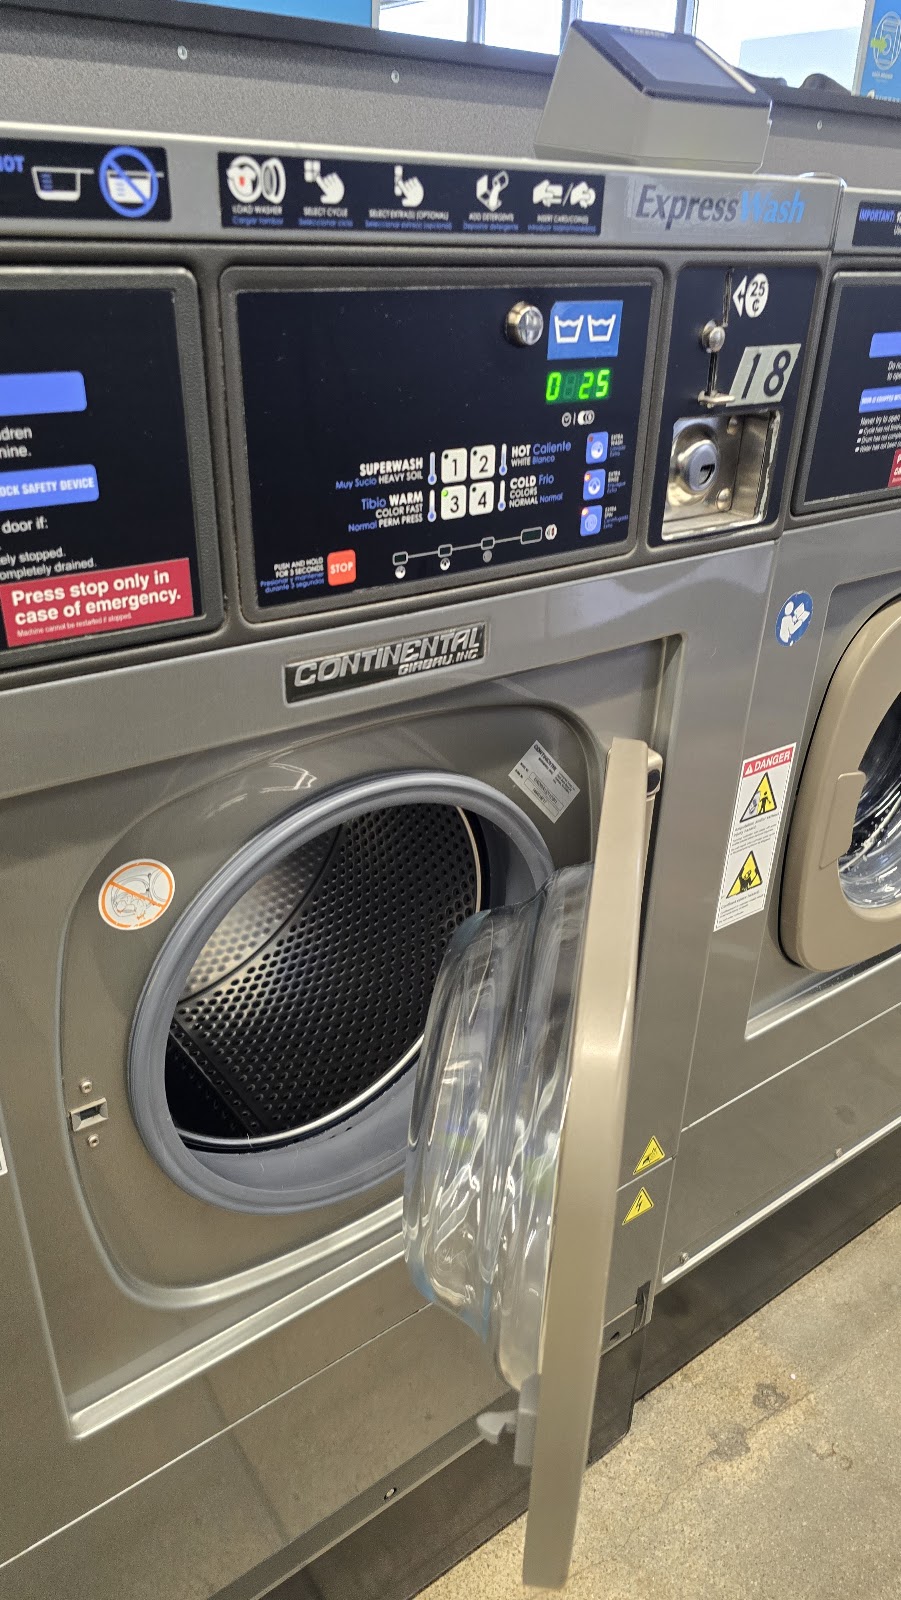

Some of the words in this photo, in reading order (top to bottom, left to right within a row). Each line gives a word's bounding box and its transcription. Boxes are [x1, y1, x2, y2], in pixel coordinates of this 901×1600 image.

[635, 184, 806, 231] ExpressWash
[750, 281, 766, 297] 25
[545, 371, 562, 401] 0
[578, 369, 611, 400] 25
[741, 351, 791, 399] 18
[0, 425, 33, 441] dren
[511, 444, 531, 458] HOT
[533, 440, 571, 455] Caliente
[359, 457, 423, 477] SUPERWASH
[452, 459, 458, 476] 1
[479, 455, 488, 473] 2
[511, 456, 531, 468] WHITE
[532, 455, 555, 465] Blanco
[0, 484, 20, 497] OCK
[22, 481, 57, 495] SAFETY
[60, 477, 95, 492] DEVICE
[335, 481, 353, 490] Muy
[355, 477, 377, 488] Sucio
[378, 472, 405, 484] HEAVY
[406, 470, 423, 481] SOIL
[510, 475, 536, 490] COLD
[361, 496, 387, 510] Tibio
[389, 490, 423, 506] WARM
[450, 495, 459, 513] 3
[478, 491, 487, 508] 4
[509, 496, 538, 508] NORMAL
[540, 492, 563, 503] Normal
[510, 486, 537, 499] COLORS
[375, 506, 405, 519] COLOR
[406, 503, 423, 514] FAST
[1, 519, 33, 534] door
[35, 515, 48, 530] if:
[348, 520, 377, 532] Normal
[378, 516, 400, 528] PERM
[401, 513, 423, 525] PRESS
[0, 553, 16, 567] ely
[18, 546, 66, 563] stopped.
[273, 562, 290, 571] PUSH
[291, 560, 305, 569] AND
[306, 556, 324, 566] HOLD
[0, 563, 52, 581] ompletely
[54, 557, 97, 573] drained.
[275, 570, 289, 578] FOR
[295, 565, 324, 575] SECONDS
[330, 561, 353, 574] STOP
[11, 587, 65, 607] Press
[69, 581, 109, 597] stop
[113, 573, 149, 592] only
[154, 570, 169, 585] in
[15, 608, 59, 626] case
[63, 601, 81, 618] of
[85, 588, 181, 611] emergency.
[17, 628, 44, 638] Machine
[45, 624, 66, 633] cannot
[67, 622, 75, 630] be
[294, 627, 480, 687] CONTINENTAL
[754, 751, 791, 772] DANGER
